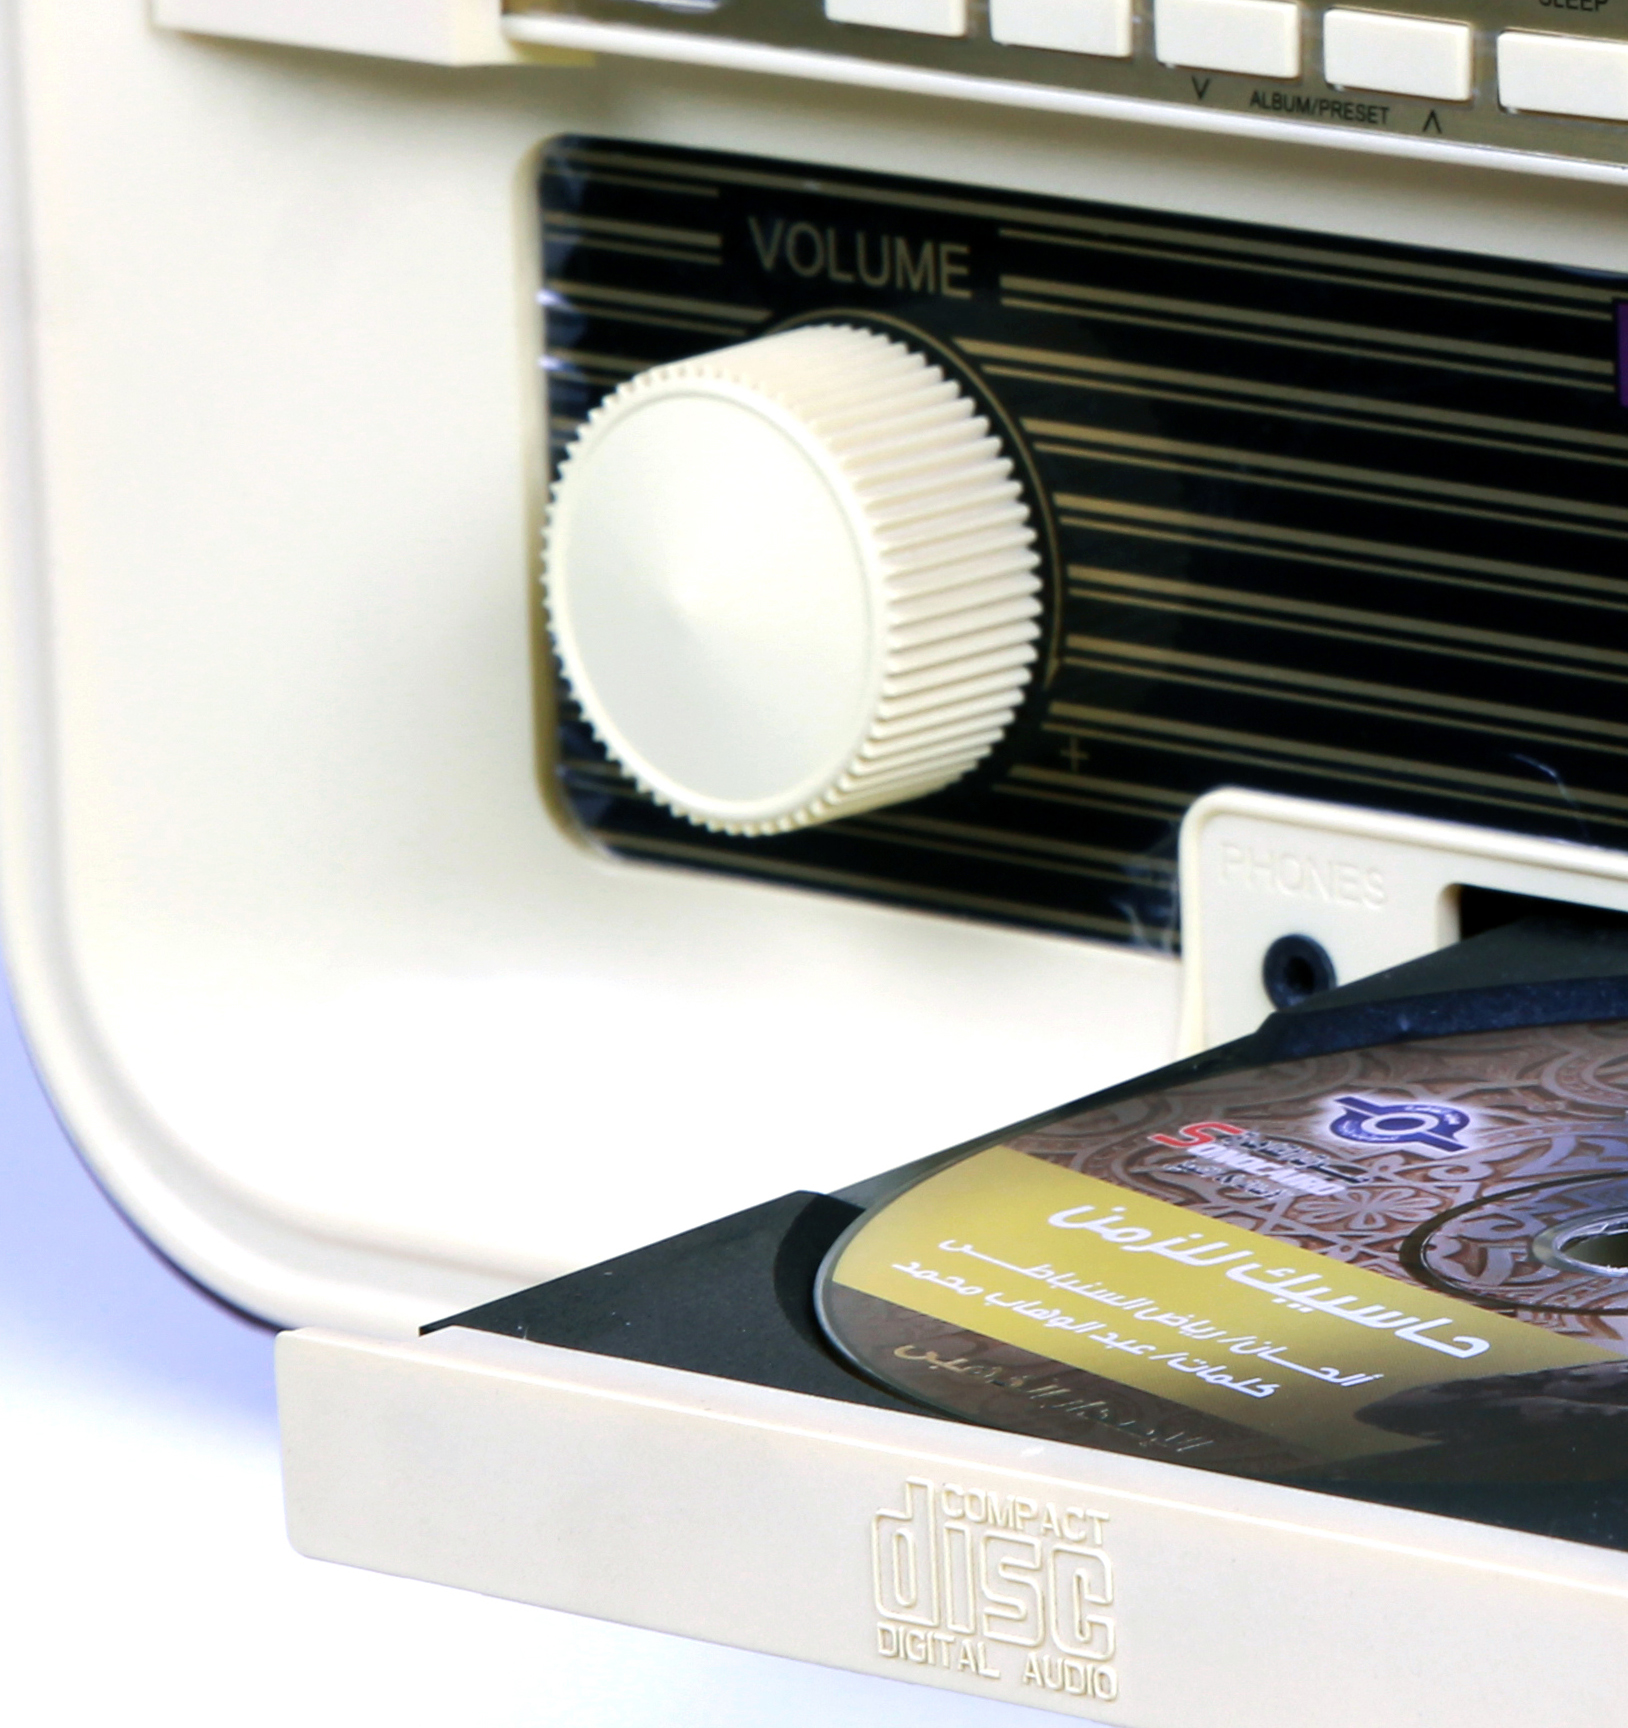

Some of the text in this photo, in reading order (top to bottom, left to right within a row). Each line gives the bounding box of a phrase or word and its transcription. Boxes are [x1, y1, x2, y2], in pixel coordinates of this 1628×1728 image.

[1248, 89, 1391, 126] ALBUM/PRESET
[746, 215, 974, 301] VOLUME
[1217, 840, 1389, 911] PHONES
[940, 1481, 1112, 1547] COMPACT
[875, 1620, 1120, 1704] DIGITAL AUDIO
